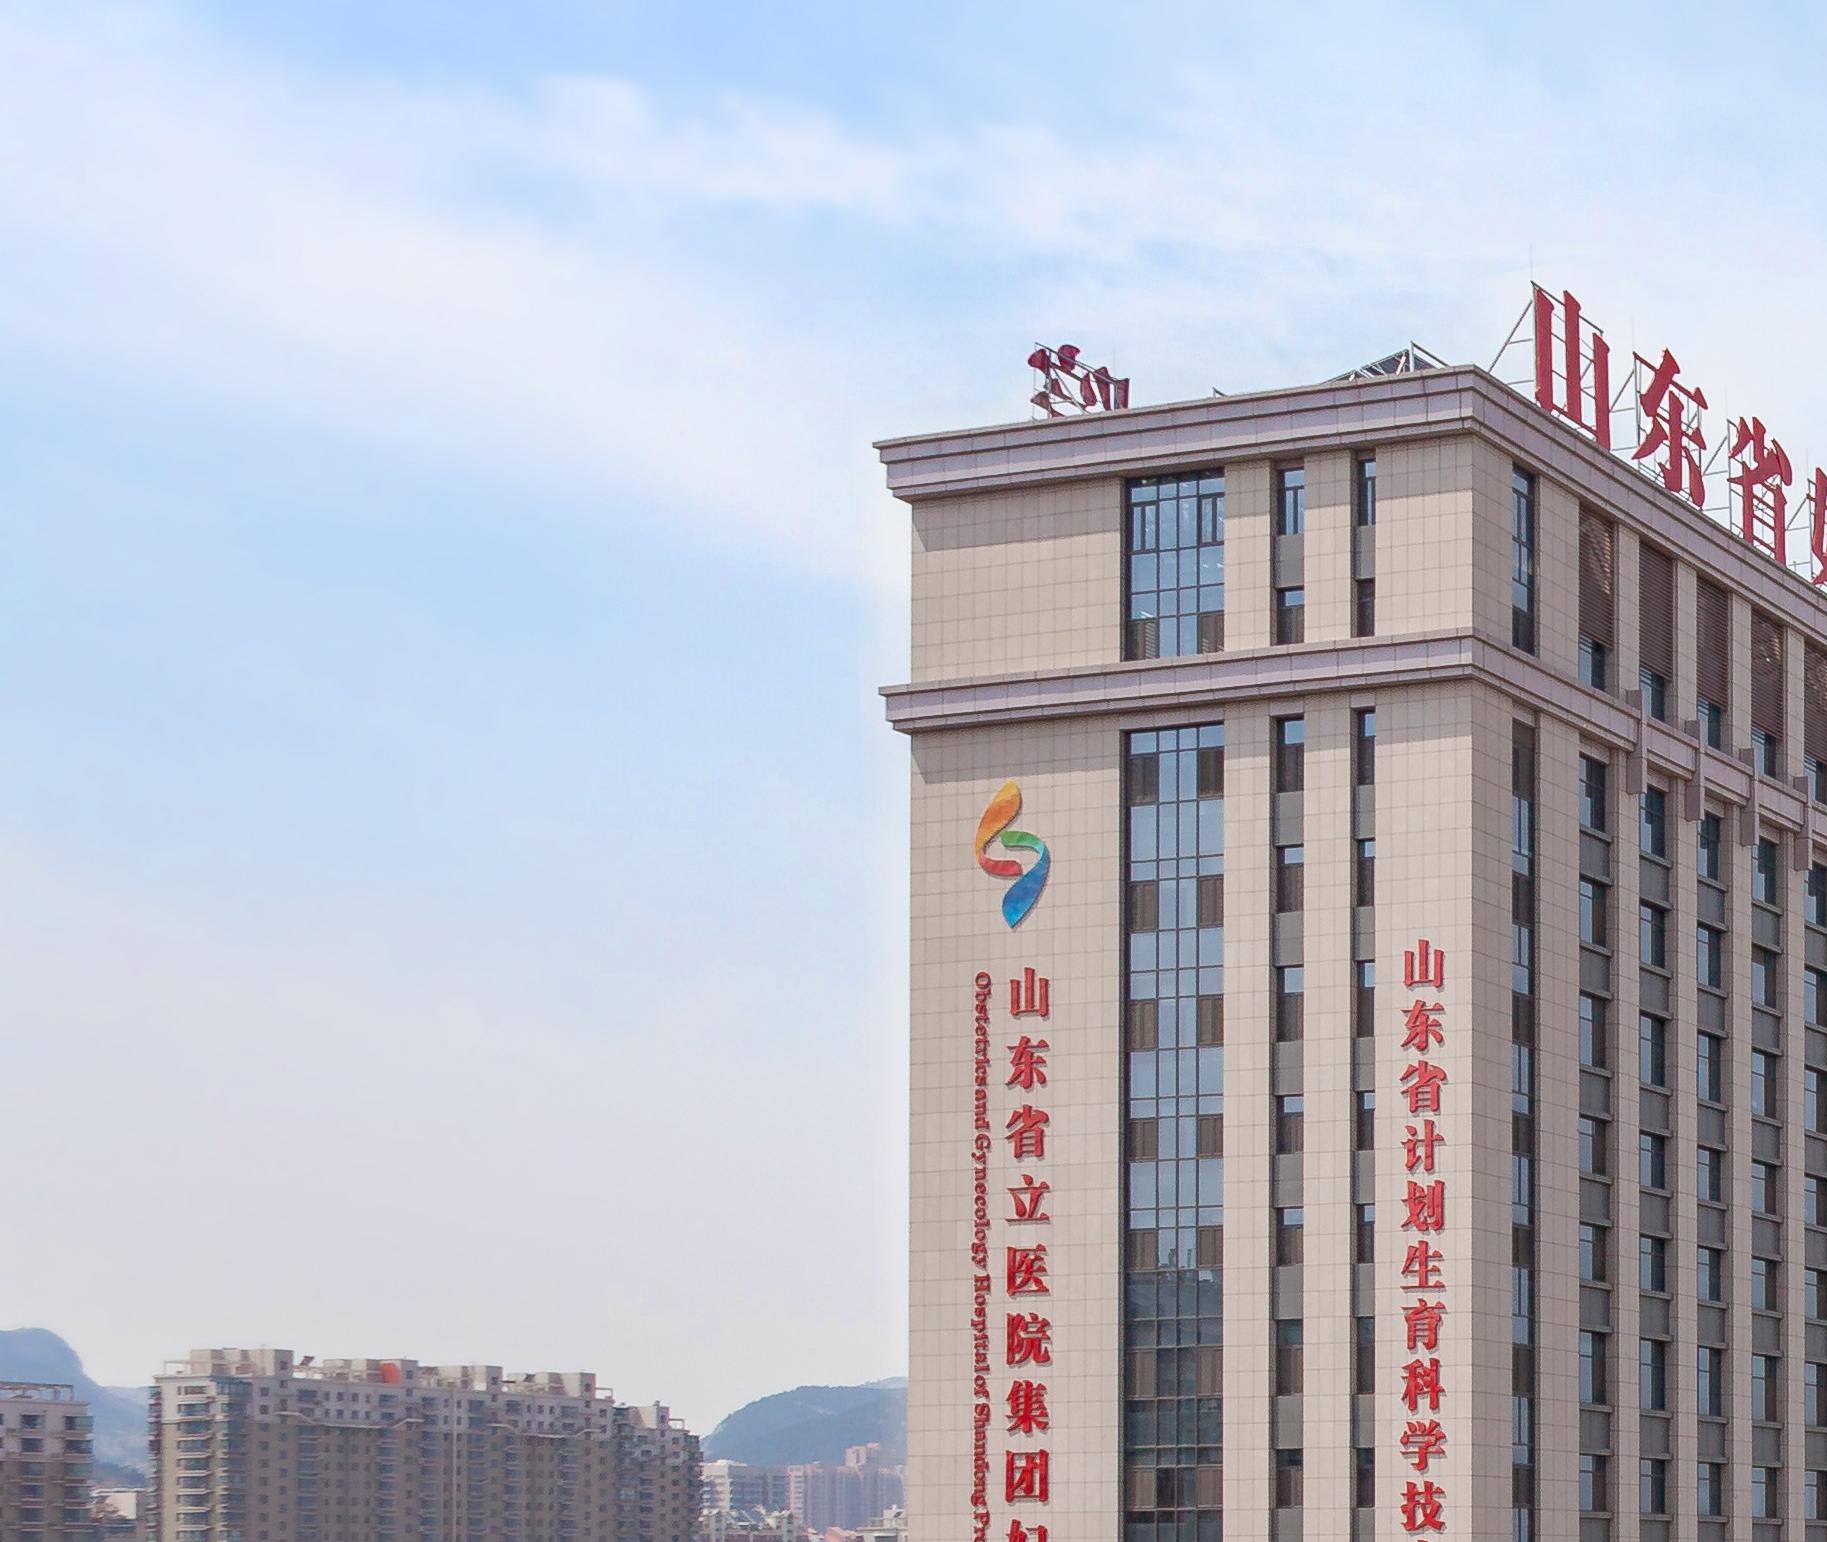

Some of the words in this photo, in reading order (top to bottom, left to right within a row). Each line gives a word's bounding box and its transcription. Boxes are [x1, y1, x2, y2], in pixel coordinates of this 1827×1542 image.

[972, 972, 992, 1086] Obstetrics
[972, 1088, 992, 1130] and
[972, 1133, 992, 1270] Gynecology
[972, 1274, 992, 1371] Hospital
[971, 1374, 990, 1399] of
[971, 1403, 990, 1507] Shandong
